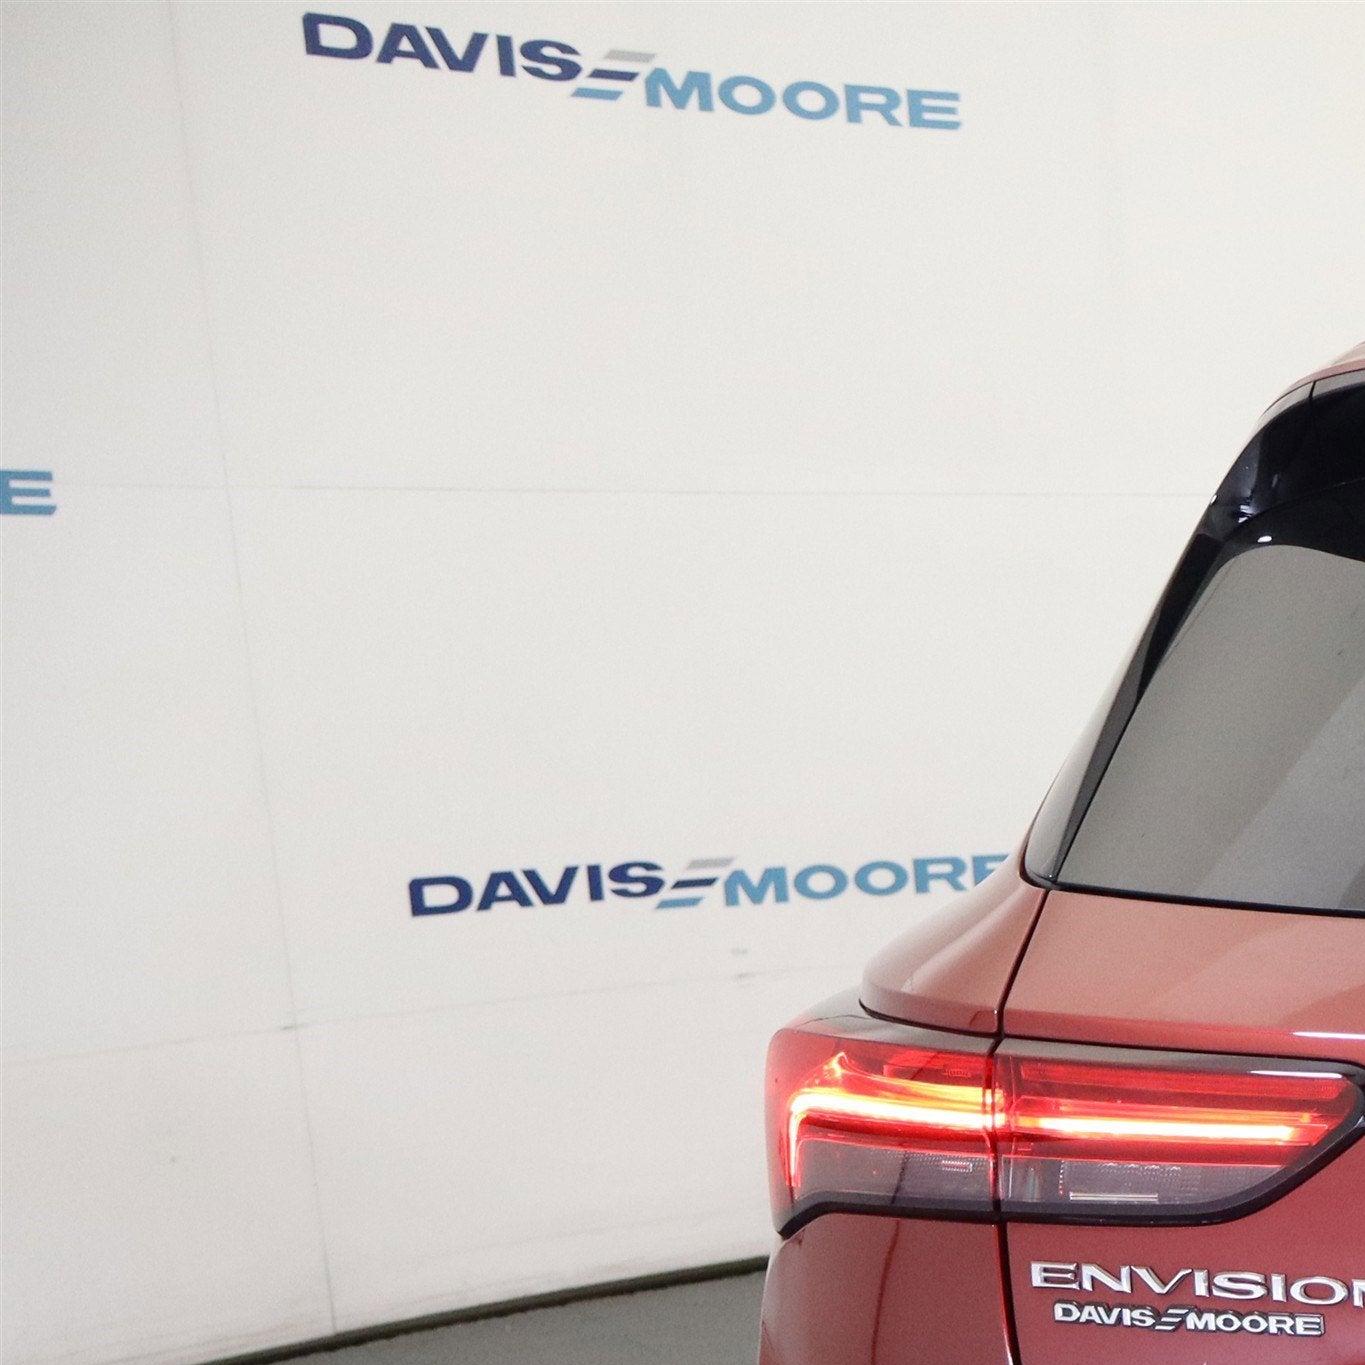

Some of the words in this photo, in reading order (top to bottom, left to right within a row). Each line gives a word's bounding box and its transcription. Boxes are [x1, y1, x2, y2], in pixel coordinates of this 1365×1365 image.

[302, 12, 583, 81] DAVIS
[643, 67, 962, 131] MOORE
[408, 862, 666, 917] DAVIS
[1054, 1302, 1156, 1328] DAVIS
[1185, 1308, 1325, 1336] MOORE
